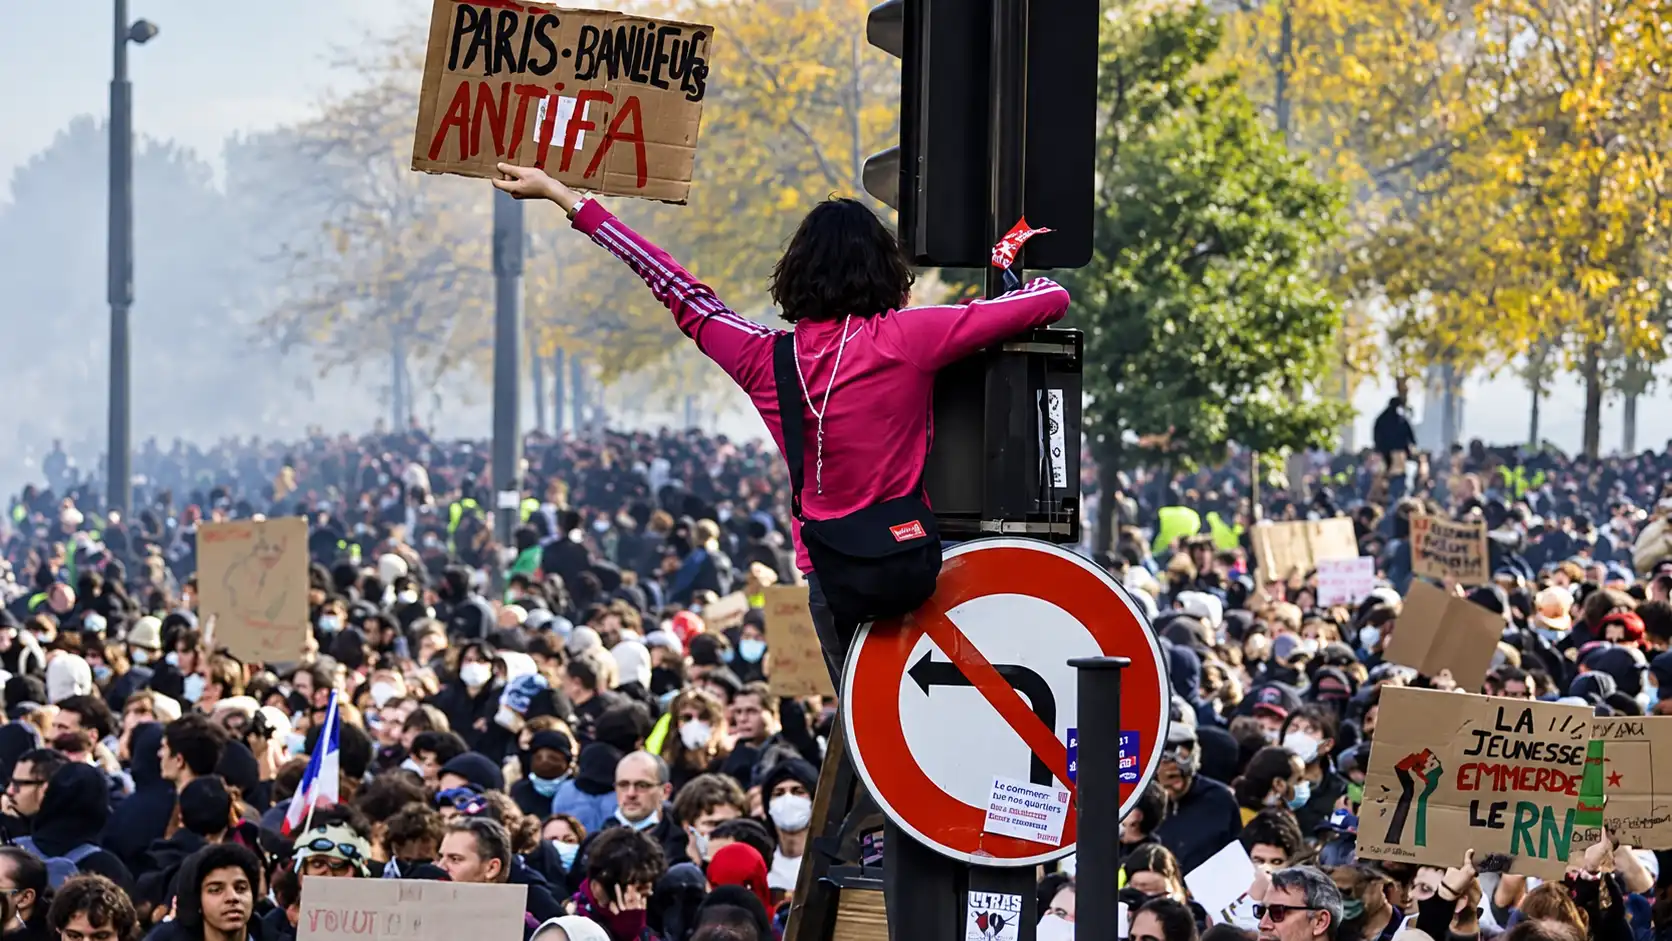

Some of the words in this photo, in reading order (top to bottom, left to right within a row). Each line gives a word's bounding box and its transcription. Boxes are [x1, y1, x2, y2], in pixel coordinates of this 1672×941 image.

[428, 80, 648, 188] ANTIFA
[1495, 706, 1534, 734] LA
[1464, 729, 1585, 766] JEUNESSE
[994, 780, 1005, 790] Le
[1456, 763, 1584, 796] EMMERDE
[1469, 800, 1508, 829] LE
[1510, 801, 1576, 862] RN
